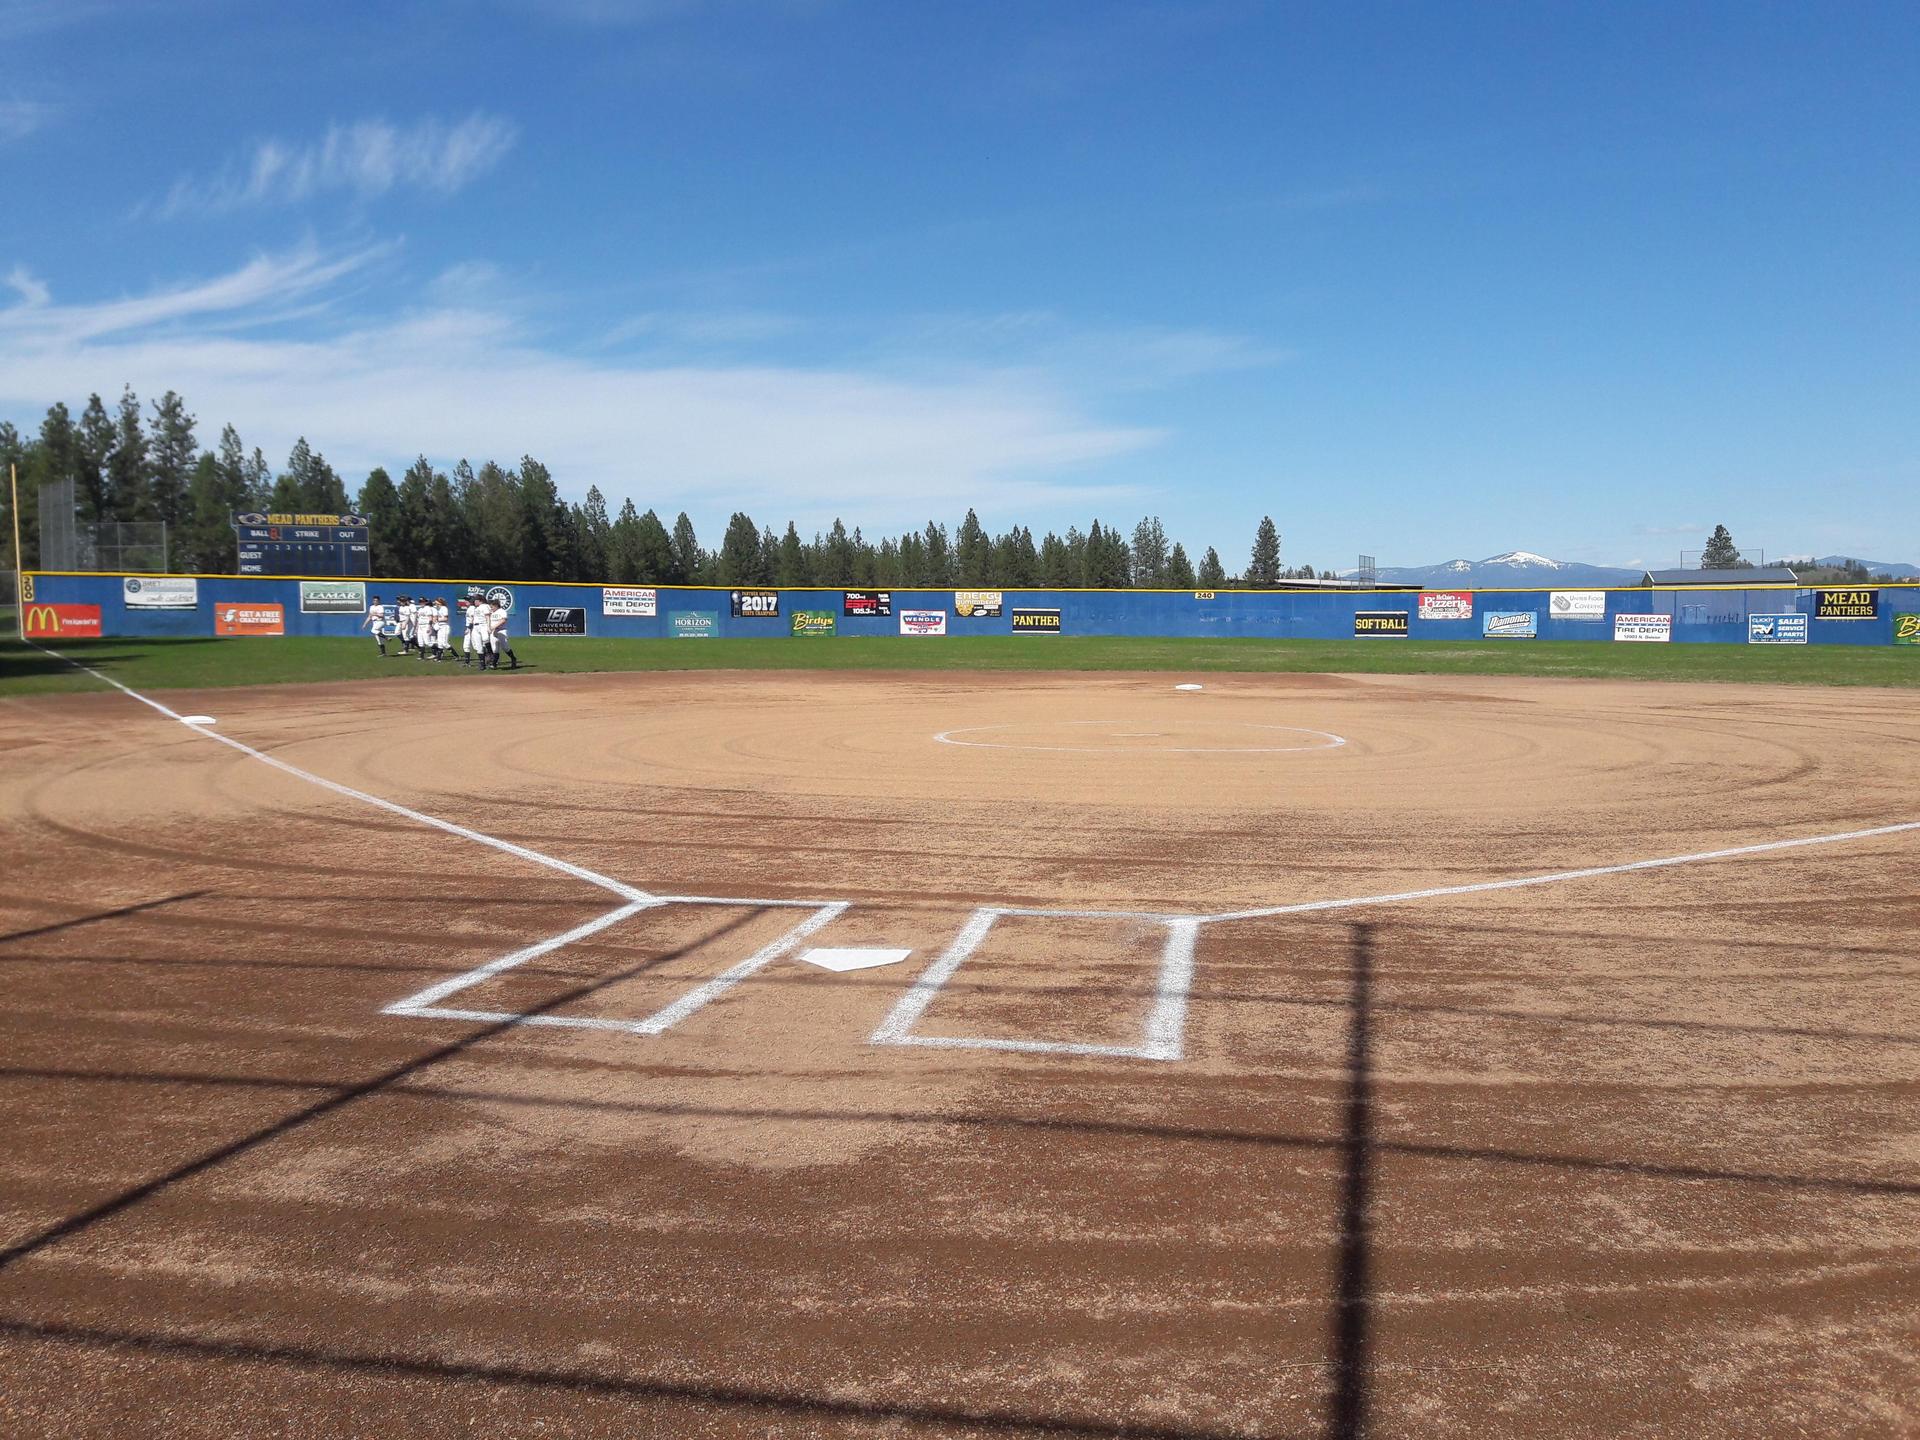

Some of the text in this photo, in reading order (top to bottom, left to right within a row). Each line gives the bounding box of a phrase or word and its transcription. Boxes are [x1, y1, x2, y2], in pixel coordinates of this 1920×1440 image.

[267, 514, 339, 525] MEAD PANTHERS
[742, 596, 778, 610] 2017
[1424, 596, 1467, 608] Pizzeria
[1824, 592, 1870, 604] MEAD
[1820, 606, 1873, 616] PANTHERS
[1013, 616, 1060, 626] PANTHER
[1356, 618, 1408, 630] SOFTBALL
[1488, 613, 1531, 630] Diamonds
